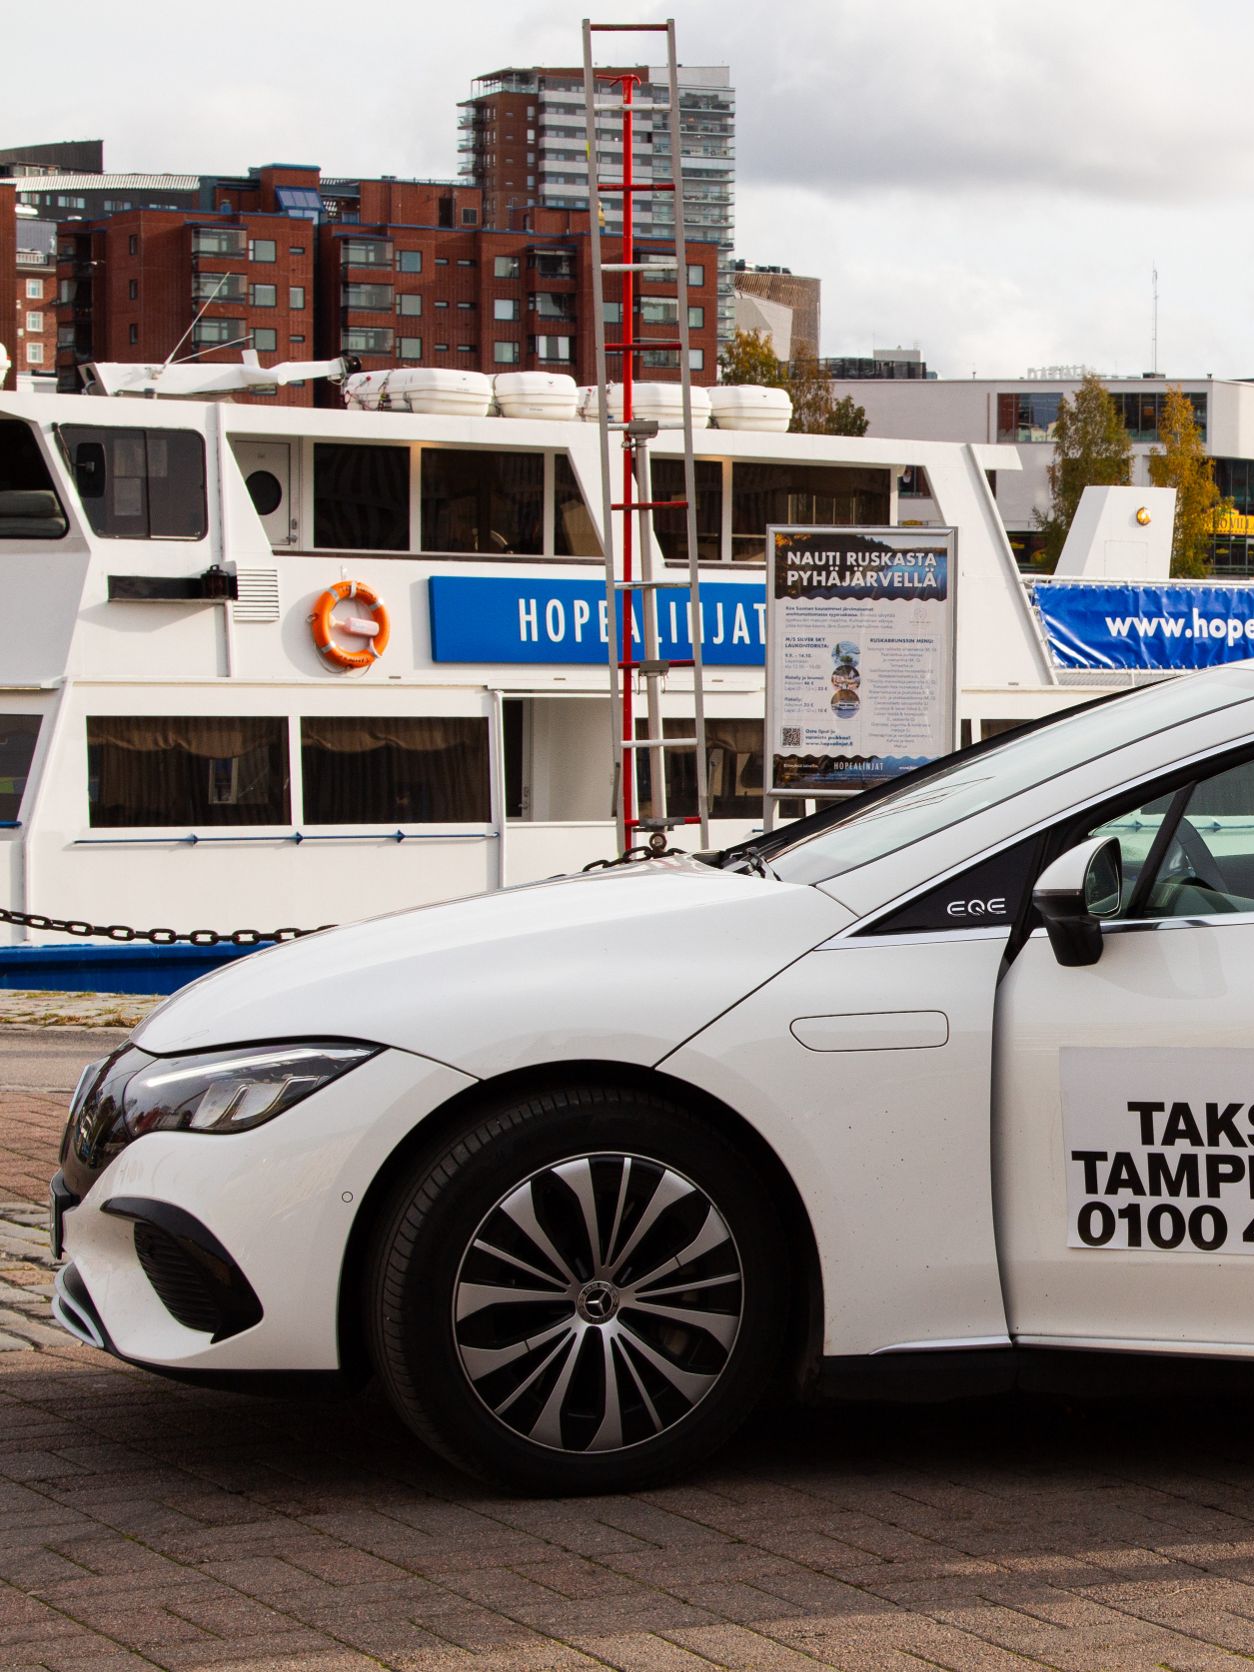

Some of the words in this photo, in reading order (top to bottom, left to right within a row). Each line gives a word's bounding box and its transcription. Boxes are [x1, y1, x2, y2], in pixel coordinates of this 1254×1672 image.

[787, 551, 840, 565] NAUTI
[846, 551, 937, 566] RUSKASTA
[787, 566, 937, 588] PYHÄJÄRVELLÄ
[833, 762, 884, 771] HOPEALINJAT
[947, 898, 1007, 916] EQE
[1077, 1201, 1228, 1251] 0100
